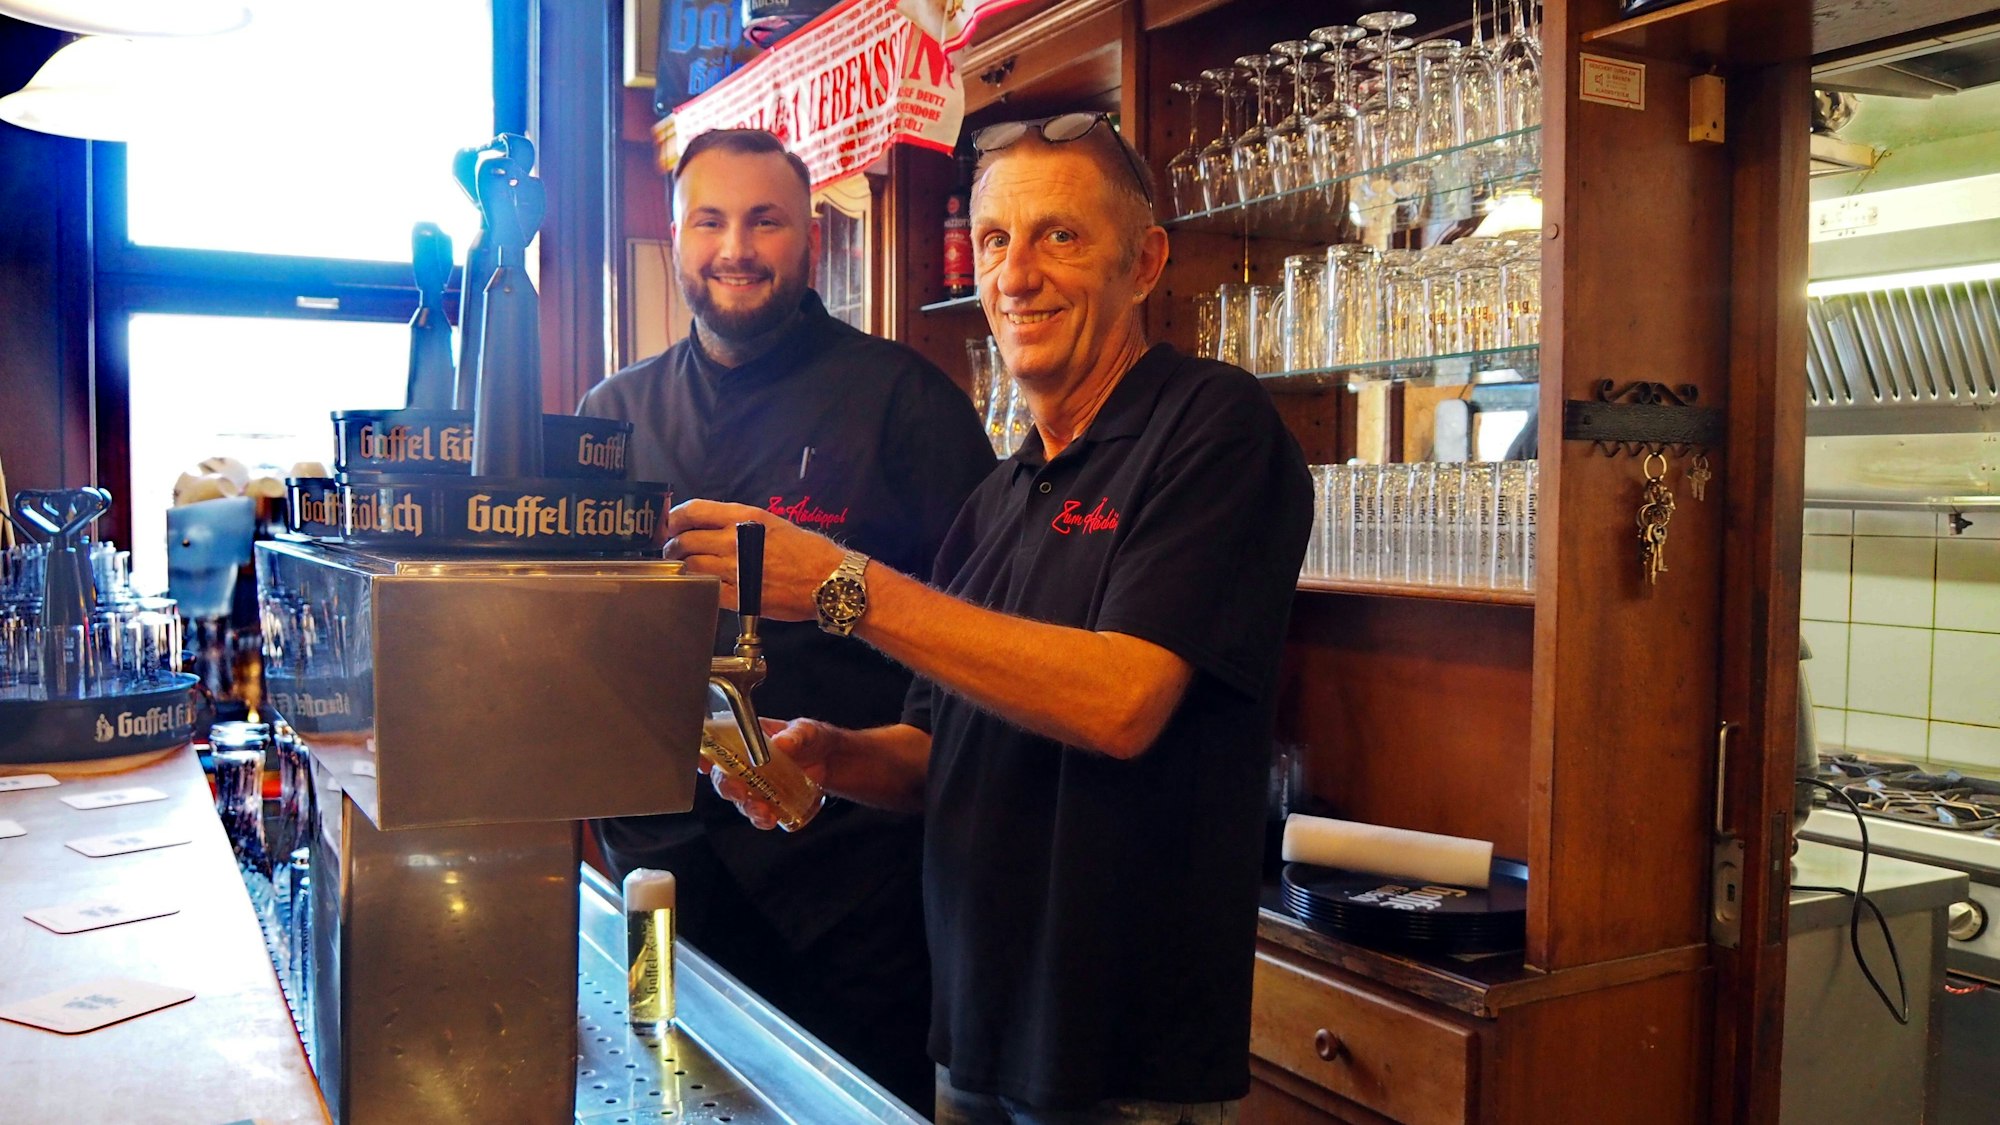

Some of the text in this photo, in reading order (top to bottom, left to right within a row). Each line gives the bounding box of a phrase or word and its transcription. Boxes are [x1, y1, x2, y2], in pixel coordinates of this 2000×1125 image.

[916, 89, 946, 107] DEUTZ
[360, 425, 435, 462] Gaffel
[467, 493, 655, 539] Gaffel Kölsch
[1052, 500, 1083, 535] Zum
[1497, 495, 1506, 526] Gaffel
[118, 705, 174, 738] Gaffel
[645, 957, 658, 994] Gaffel
